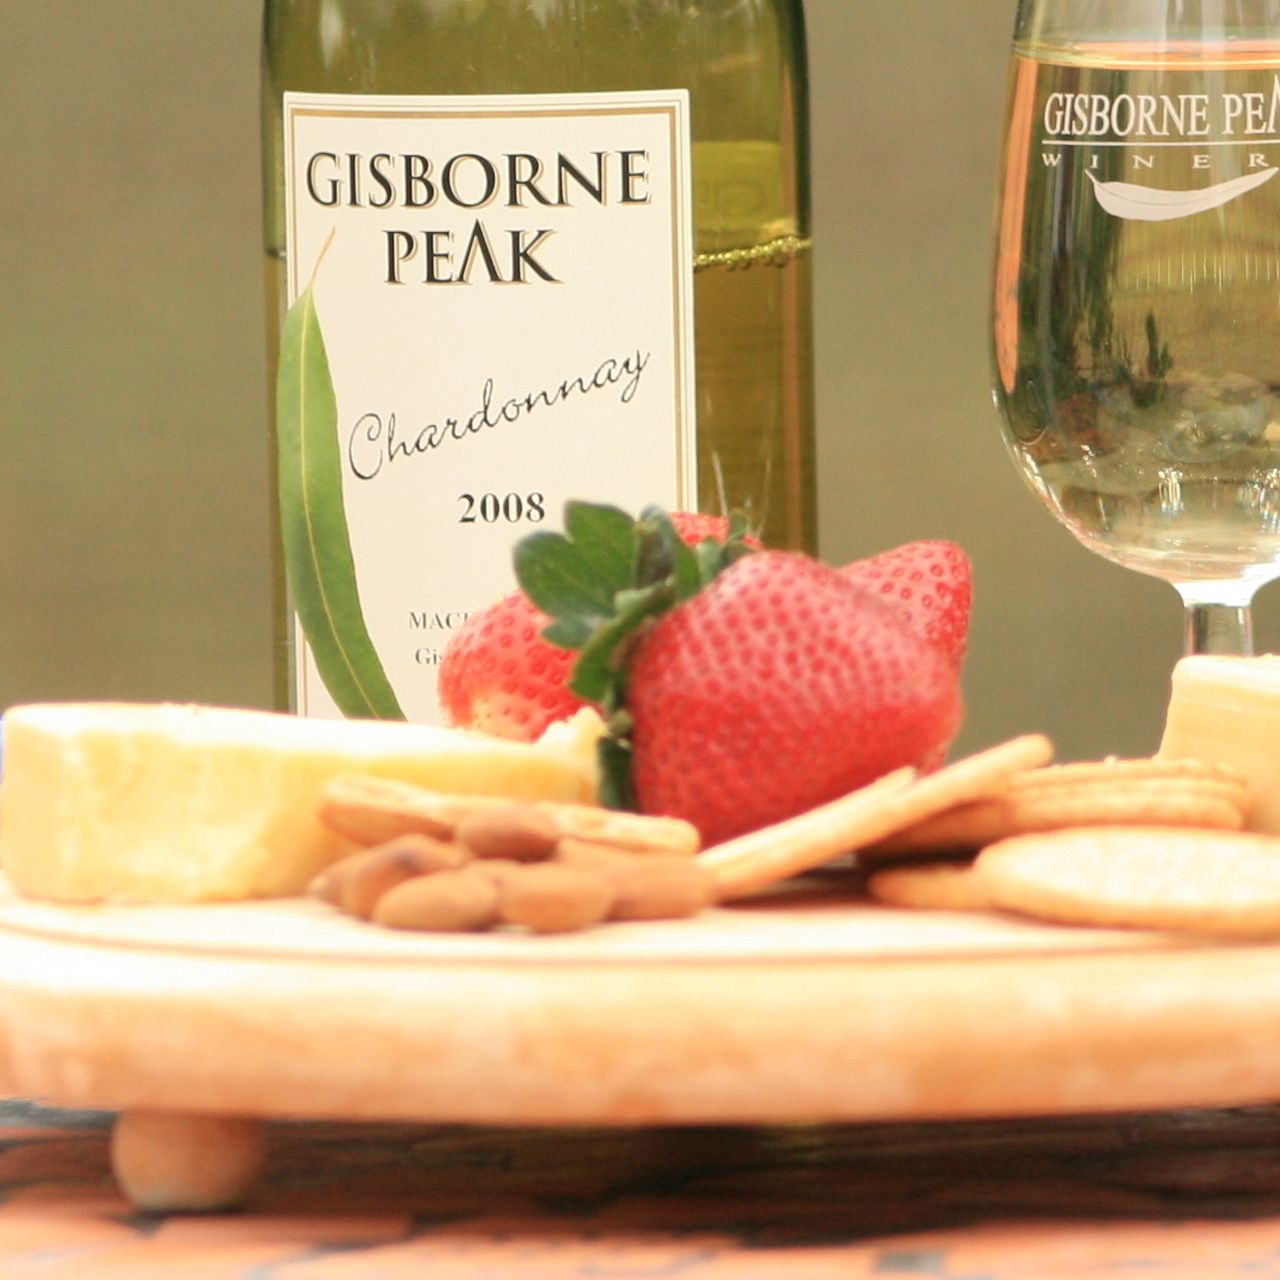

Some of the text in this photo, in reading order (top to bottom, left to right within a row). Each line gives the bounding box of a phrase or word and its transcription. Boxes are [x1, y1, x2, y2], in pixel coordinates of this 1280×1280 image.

[1044, 92, 1210, 136] GISBORNE
[306, 149, 652, 208] GISBORNE
[382, 218, 565, 284] PEAK
[348, 349, 651, 480] Chardonnay
[458, 492, 546, 524] 2008
